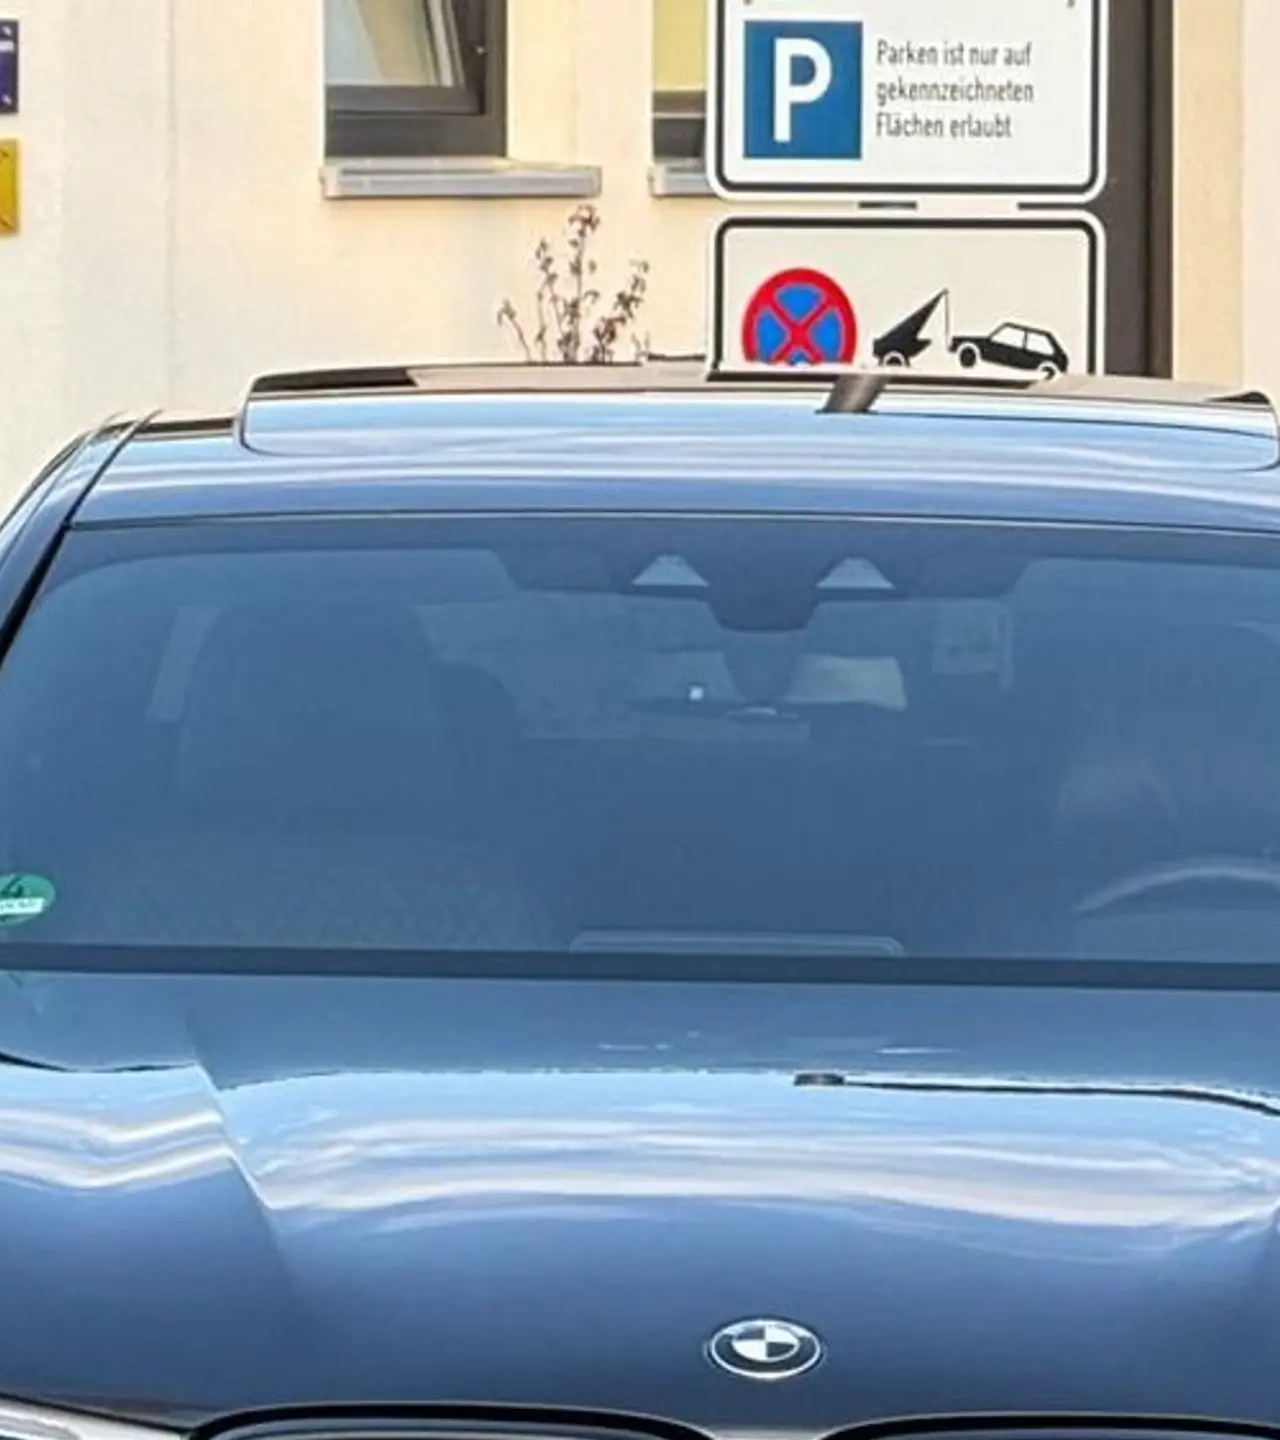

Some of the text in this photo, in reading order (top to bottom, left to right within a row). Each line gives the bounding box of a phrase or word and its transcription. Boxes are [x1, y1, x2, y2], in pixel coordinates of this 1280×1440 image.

[876, 39, 1033, 67] Parken ist nur auf
[773, 37, 833, 143] P
[876, 76, 1035, 107] gekennzeichneten
[876, 112, 1012, 138] Flächen erlaubt
